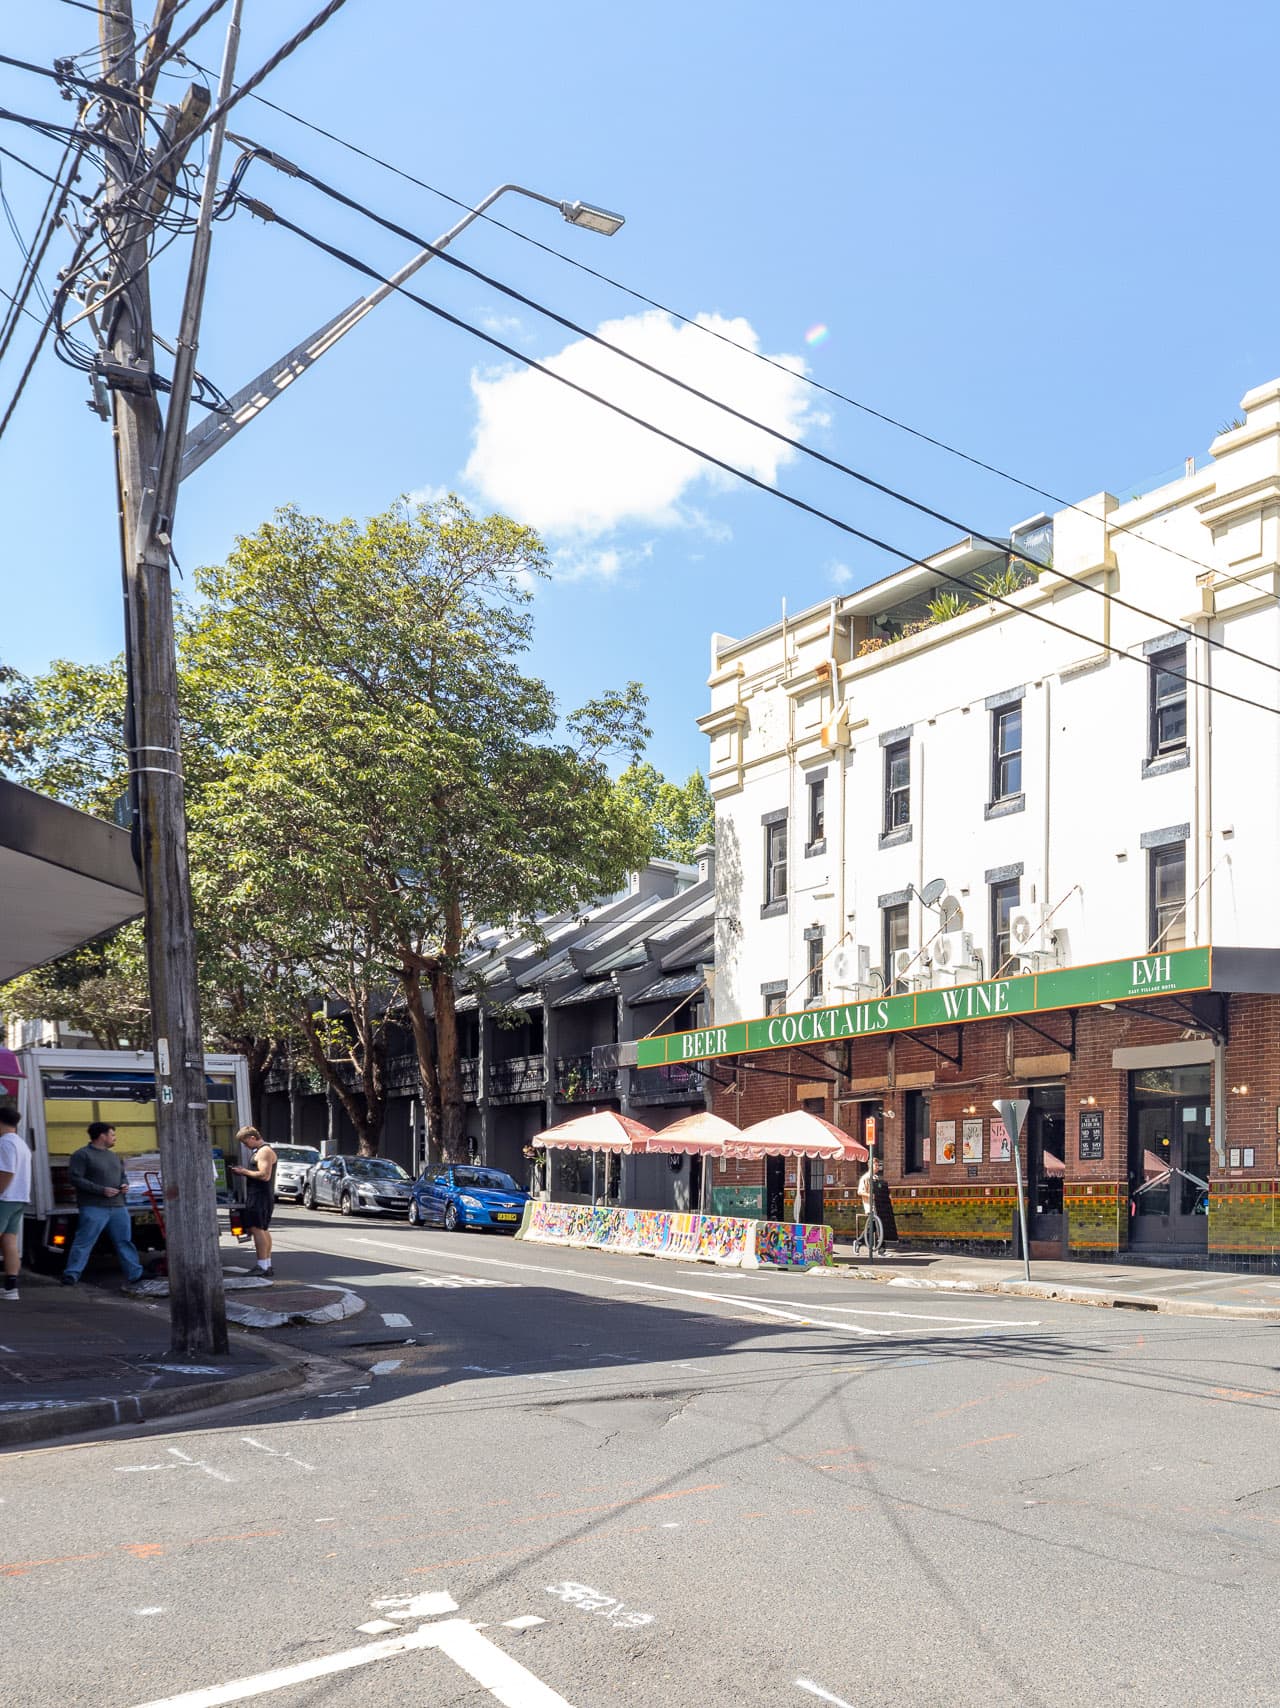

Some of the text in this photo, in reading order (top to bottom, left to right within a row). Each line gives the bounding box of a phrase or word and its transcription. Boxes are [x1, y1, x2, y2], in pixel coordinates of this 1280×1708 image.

[1132, 955, 1171, 986] EVH
[1141, 985, 1160, 993] VILLAGE
[682, 981, 1010, 1059] BEER COCKTAILS WINE
